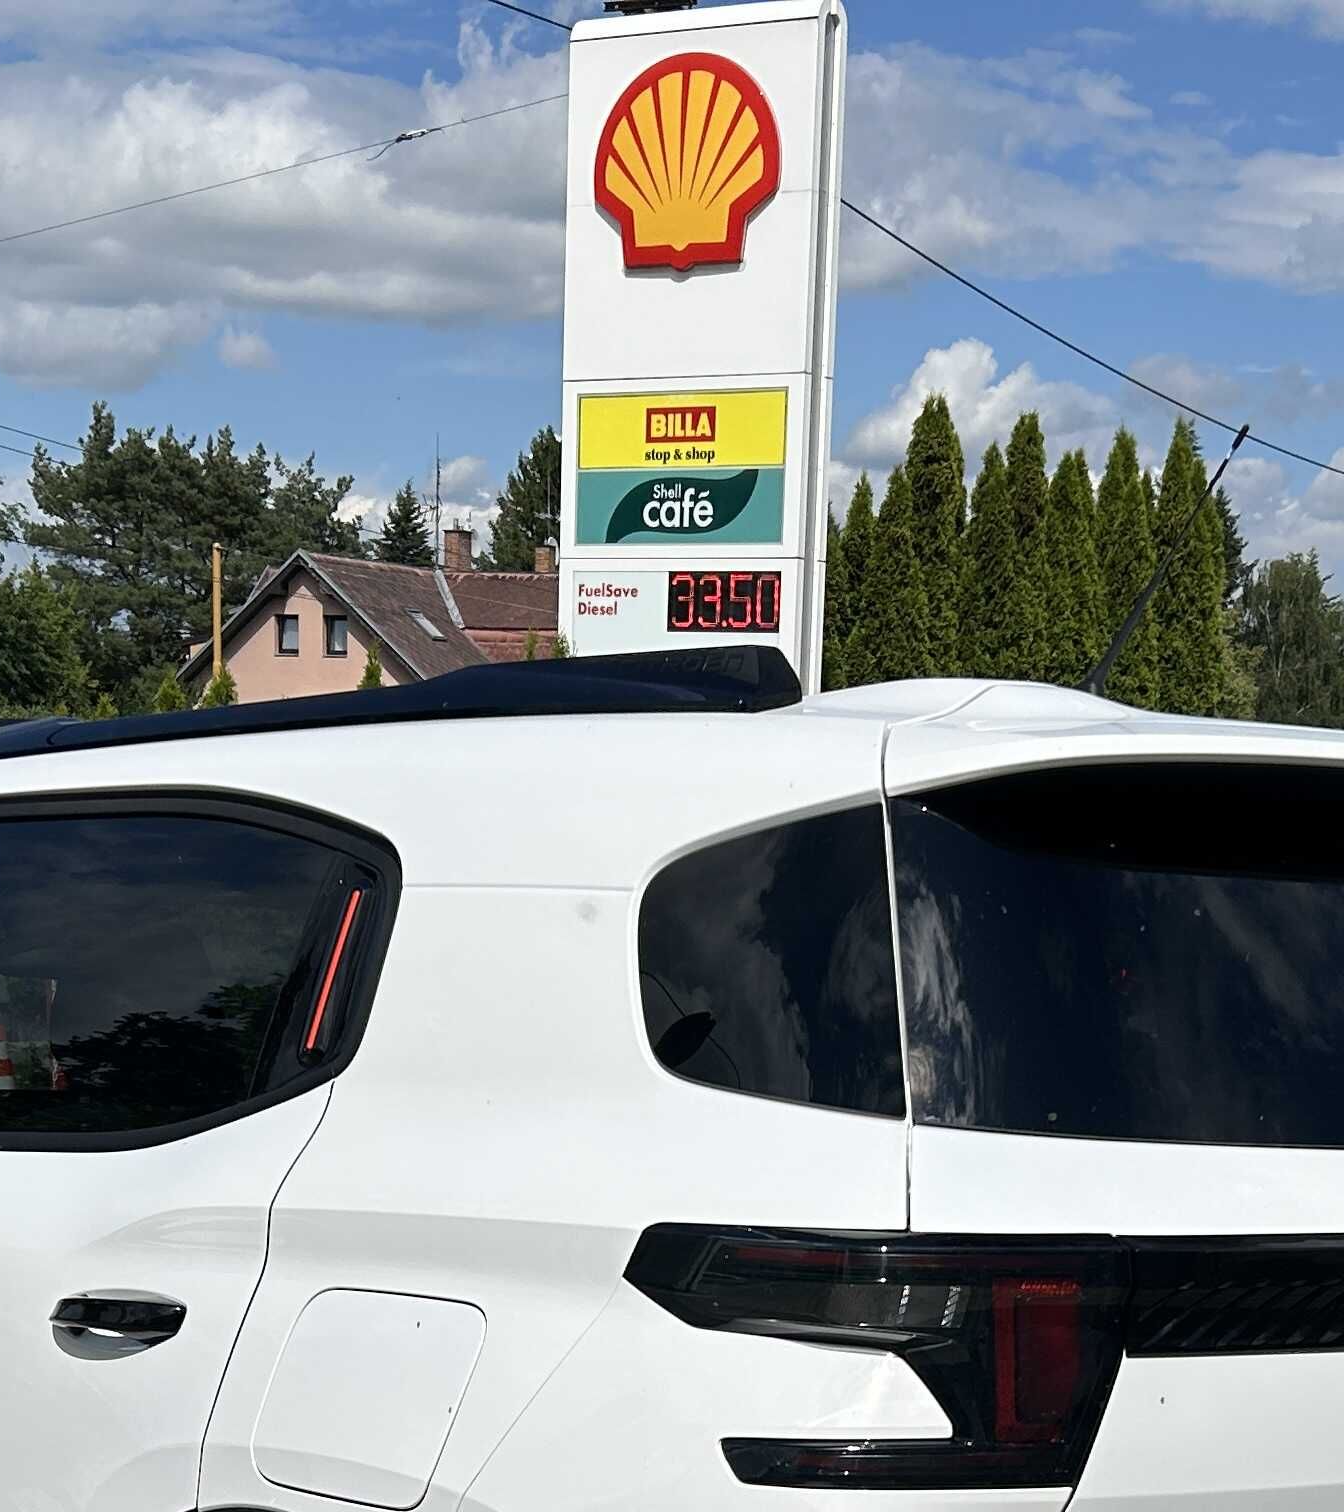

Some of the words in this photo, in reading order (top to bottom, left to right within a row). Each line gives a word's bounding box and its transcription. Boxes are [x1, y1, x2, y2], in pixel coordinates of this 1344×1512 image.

[650, 412, 712, 438] BILLA
[644, 448, 671, 464] stop
[673, 449, 684, 461] &
[685, 446, 716, 463] shop
[652, 482, 682, 499] Shell
[642, 487, 714, 528] café
[577, 582, 639, 598] FuelSave
[577, 601, 618, 616] Diesel
[670, 573, 781, 629] 33.50
